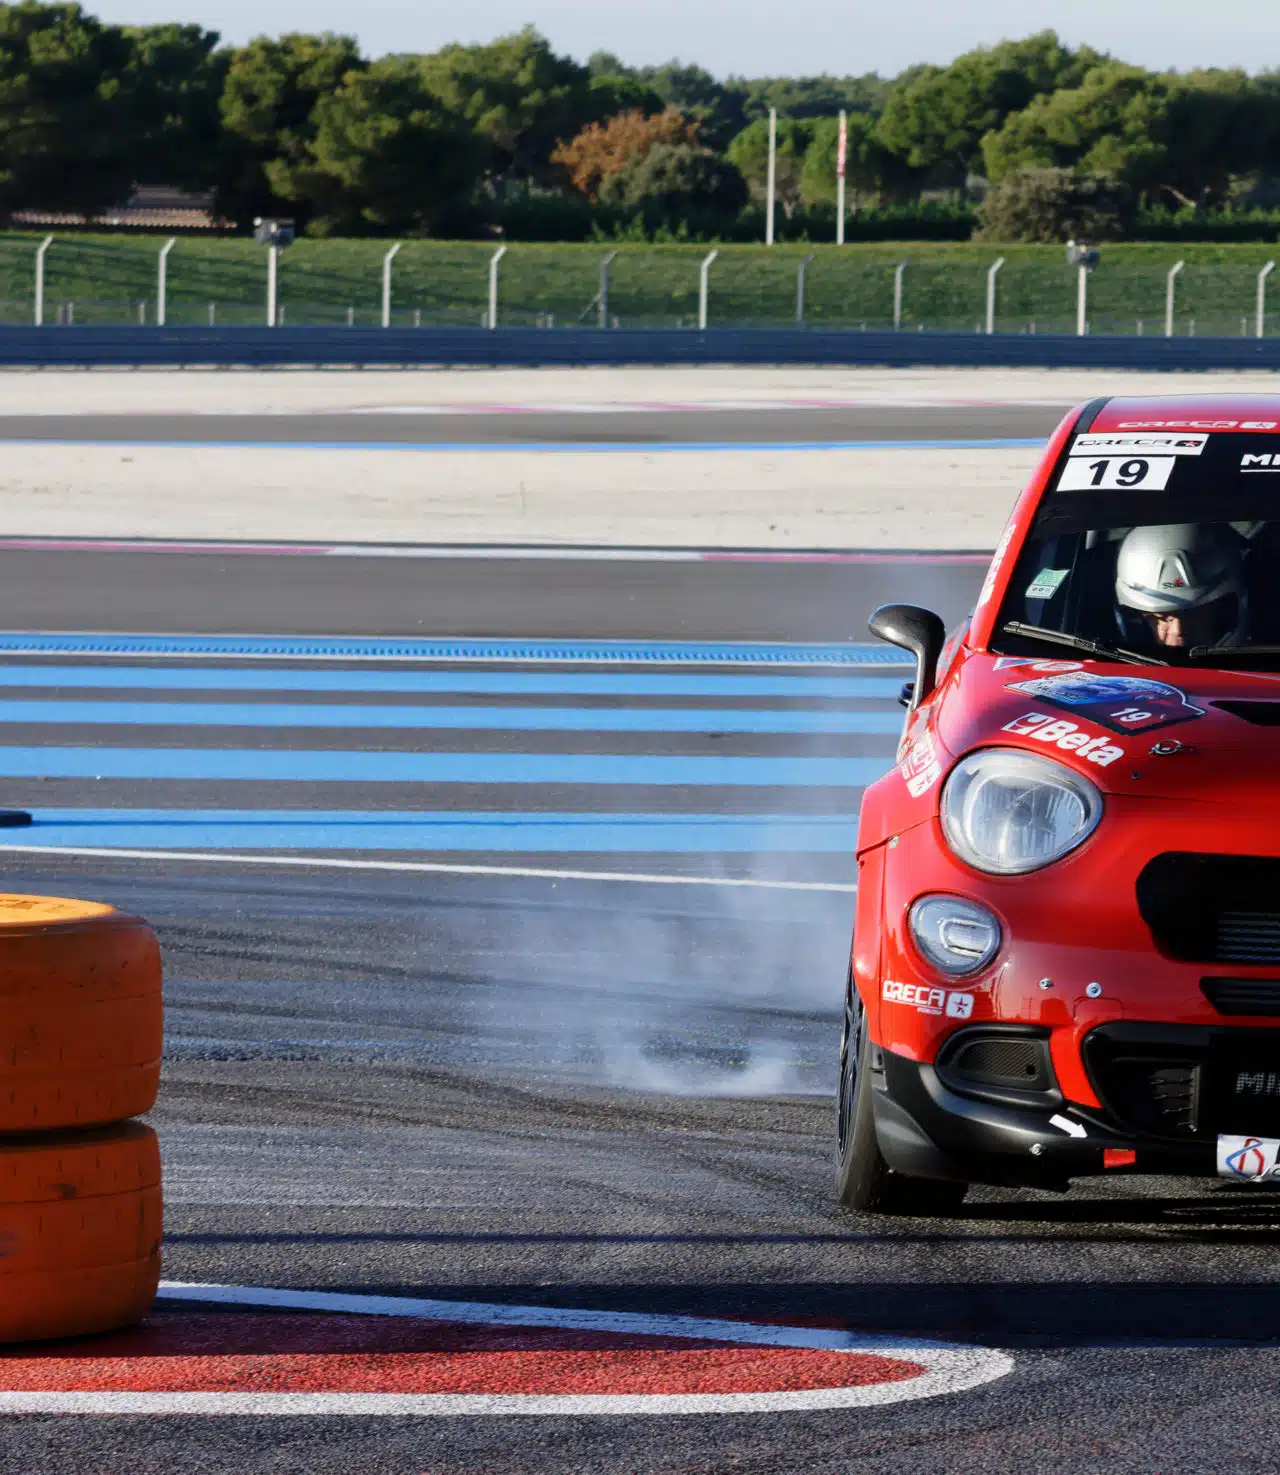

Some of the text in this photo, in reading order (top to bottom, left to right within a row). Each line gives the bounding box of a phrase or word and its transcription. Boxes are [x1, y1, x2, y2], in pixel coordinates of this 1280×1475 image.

[1077, 439, 1172, 447] ORECA
[1088, 459, 1150, 487] 19
[1110, 707, 1152, 722] 19
[1028, 720, 1125, 767] Beta
[882, 980, 946, 1007] ORECA
